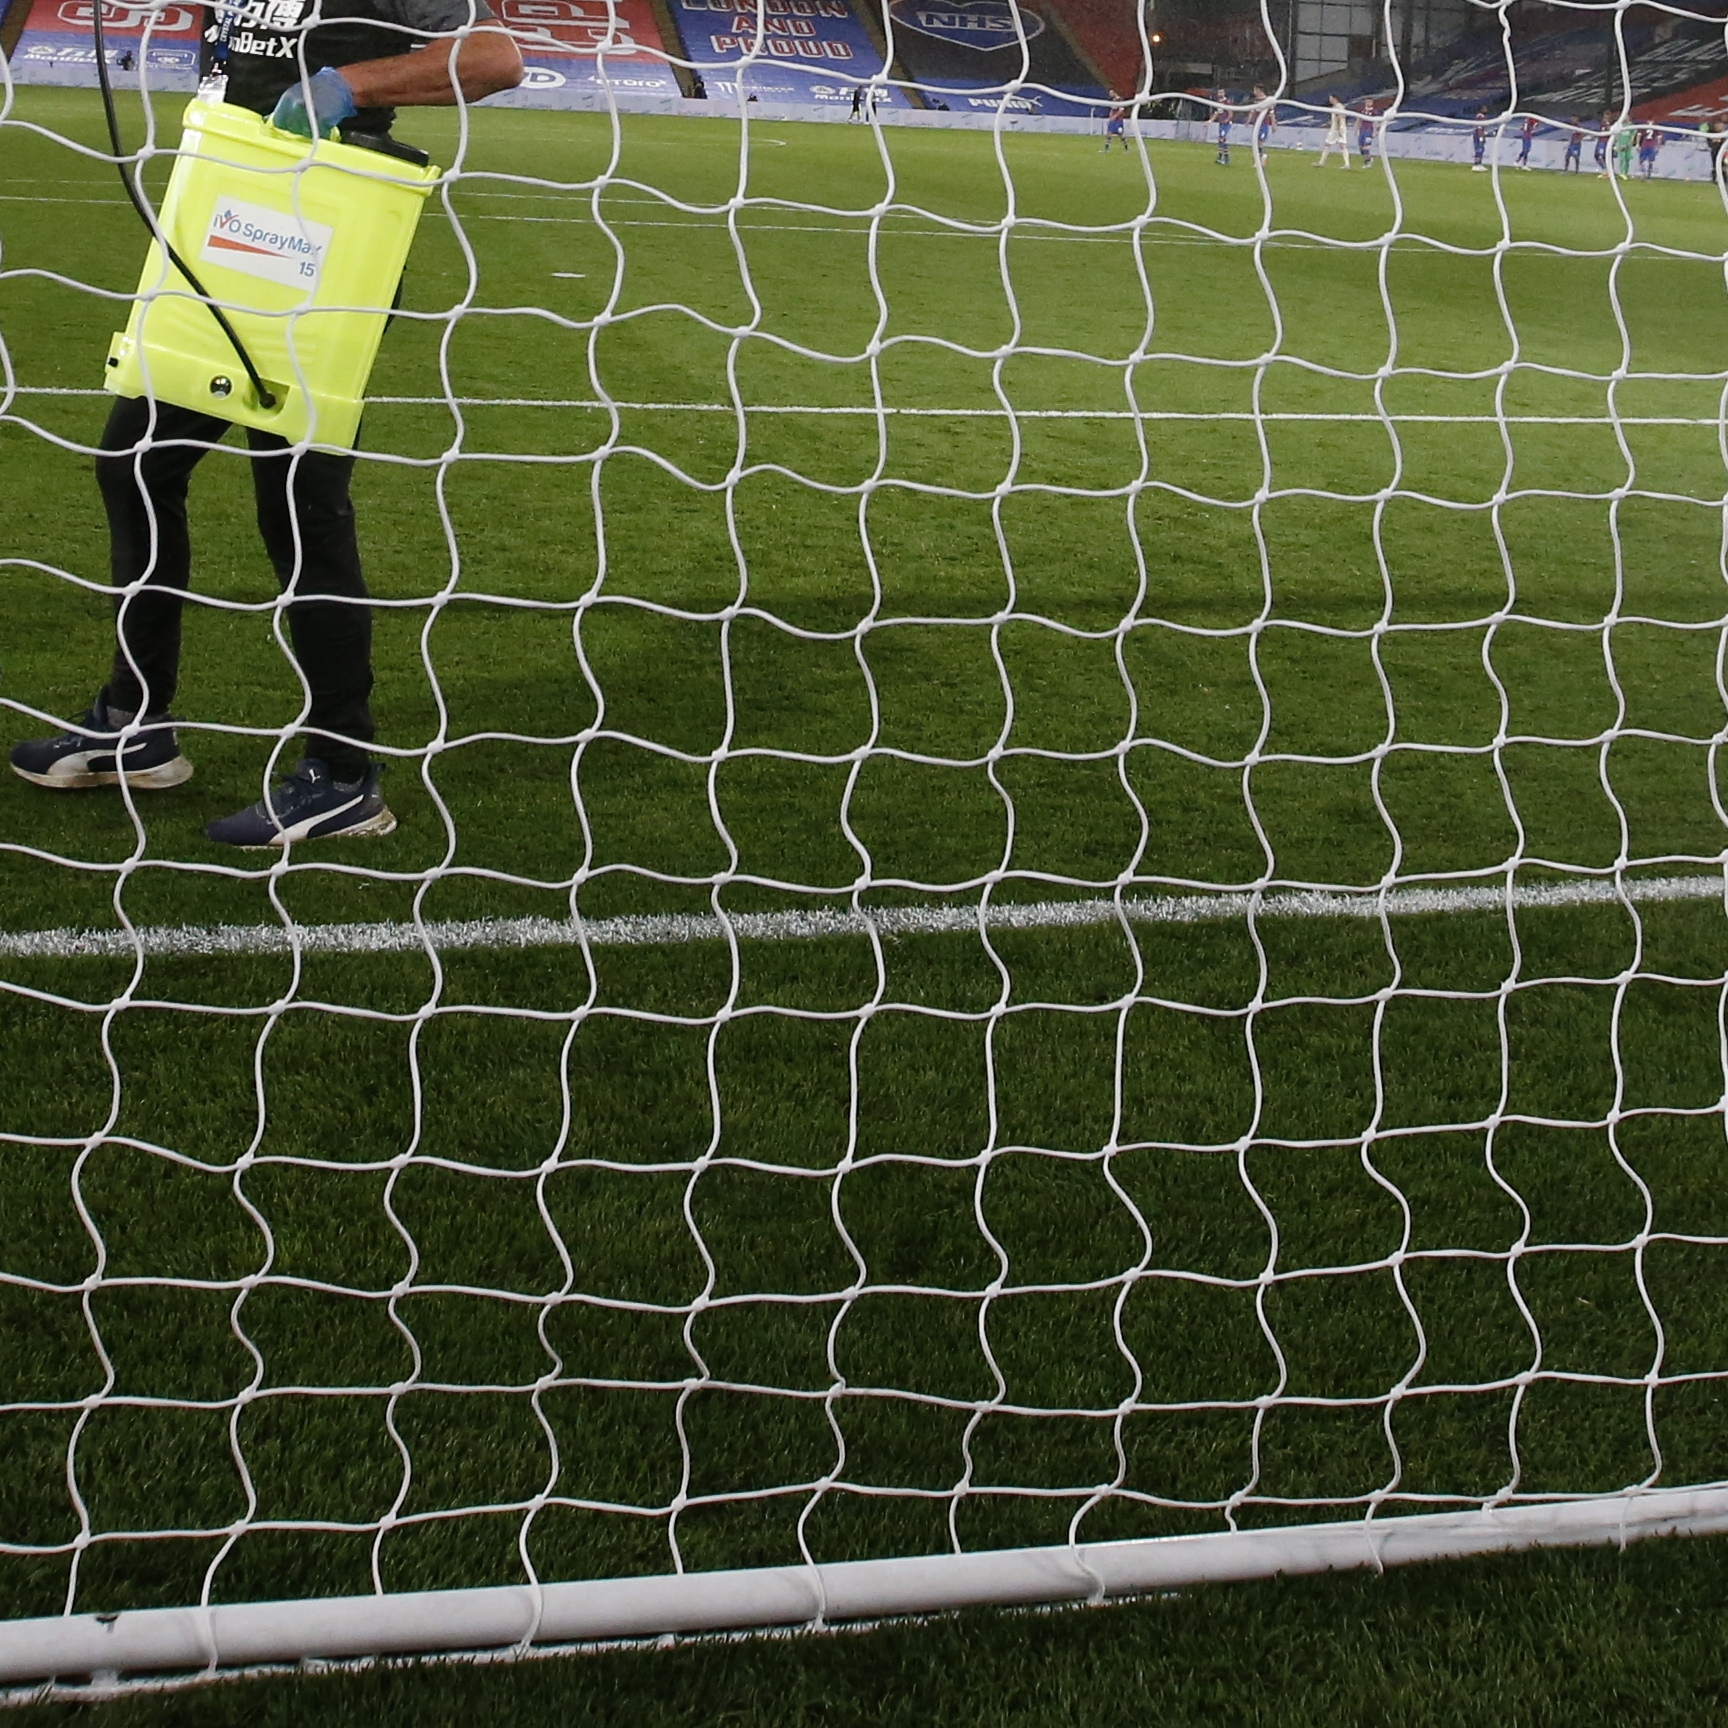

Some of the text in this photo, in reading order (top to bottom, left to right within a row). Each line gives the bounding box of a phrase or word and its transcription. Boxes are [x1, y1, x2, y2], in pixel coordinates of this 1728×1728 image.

[731, 15, 817, 37] AND
[925, 13, 1018, 30] NHS
[710, 35, 854, 60] PROUD
[299, 261, 315, 277] 15
